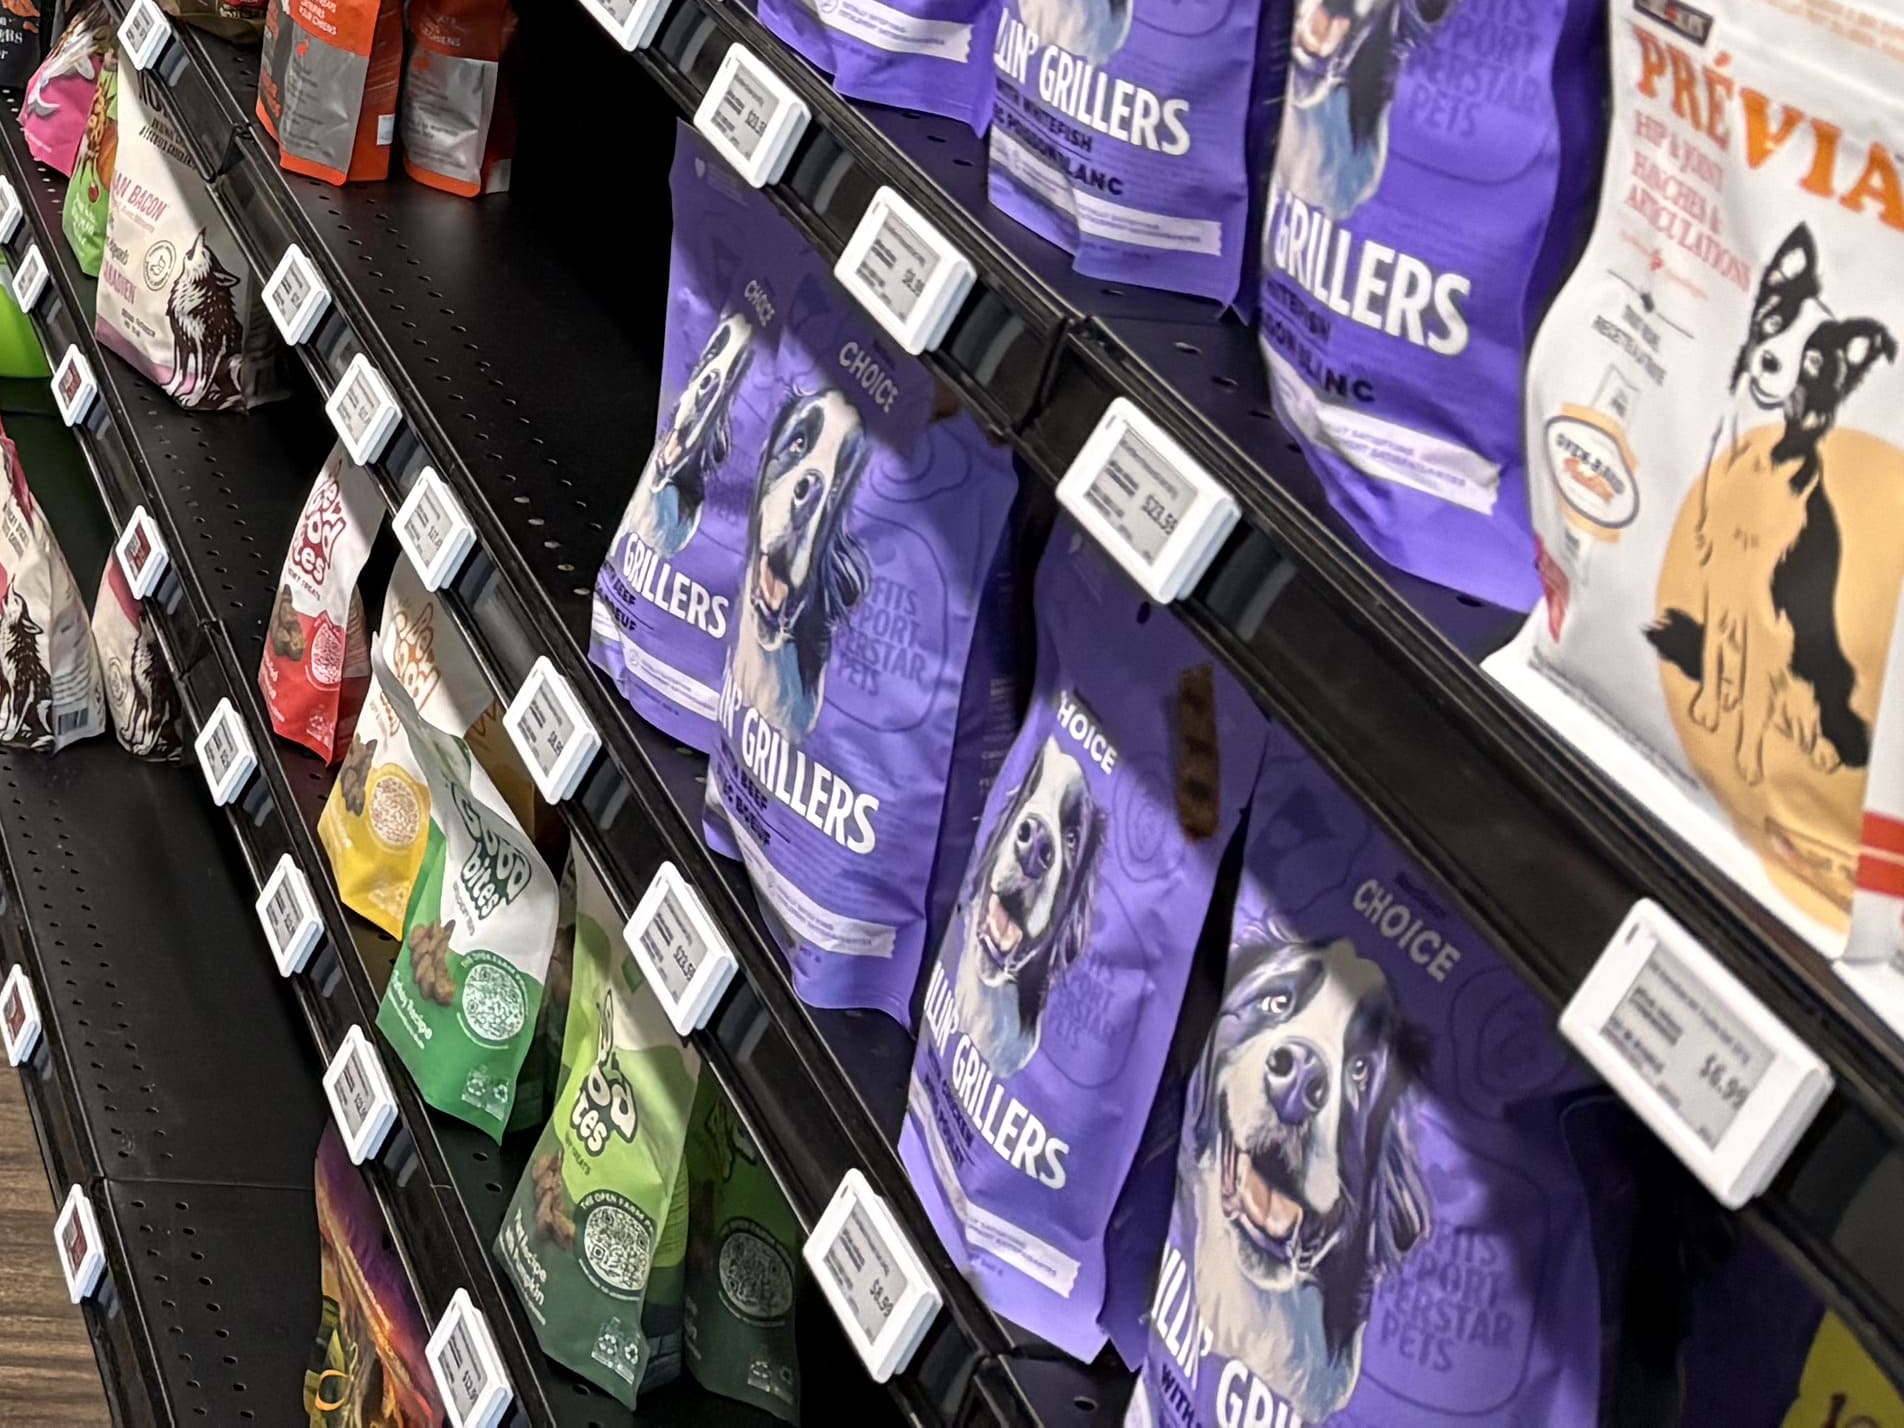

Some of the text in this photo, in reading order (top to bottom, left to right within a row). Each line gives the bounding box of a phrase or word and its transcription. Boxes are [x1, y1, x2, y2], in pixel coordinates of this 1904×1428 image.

[1039, 45, 1191, 156] GRILLERS
[128, 184, 167, 222] BACON
[743, 278, 777, 329] CHOICE
[1275, 201, 1471, 356] GRILLERS
[839, 341, 900, 415] CHOICE
[623, 532, 729, 639] GRILLERS
[742, 706, 880, 855] GRILLERS
[461, 843, 511, 921] bites
[1352, 876, 1461, 983] CHOICE
[951, 1033, 1070, 1190] GRILLERS
[1699, 1053, 1750, 1110] $6.99
